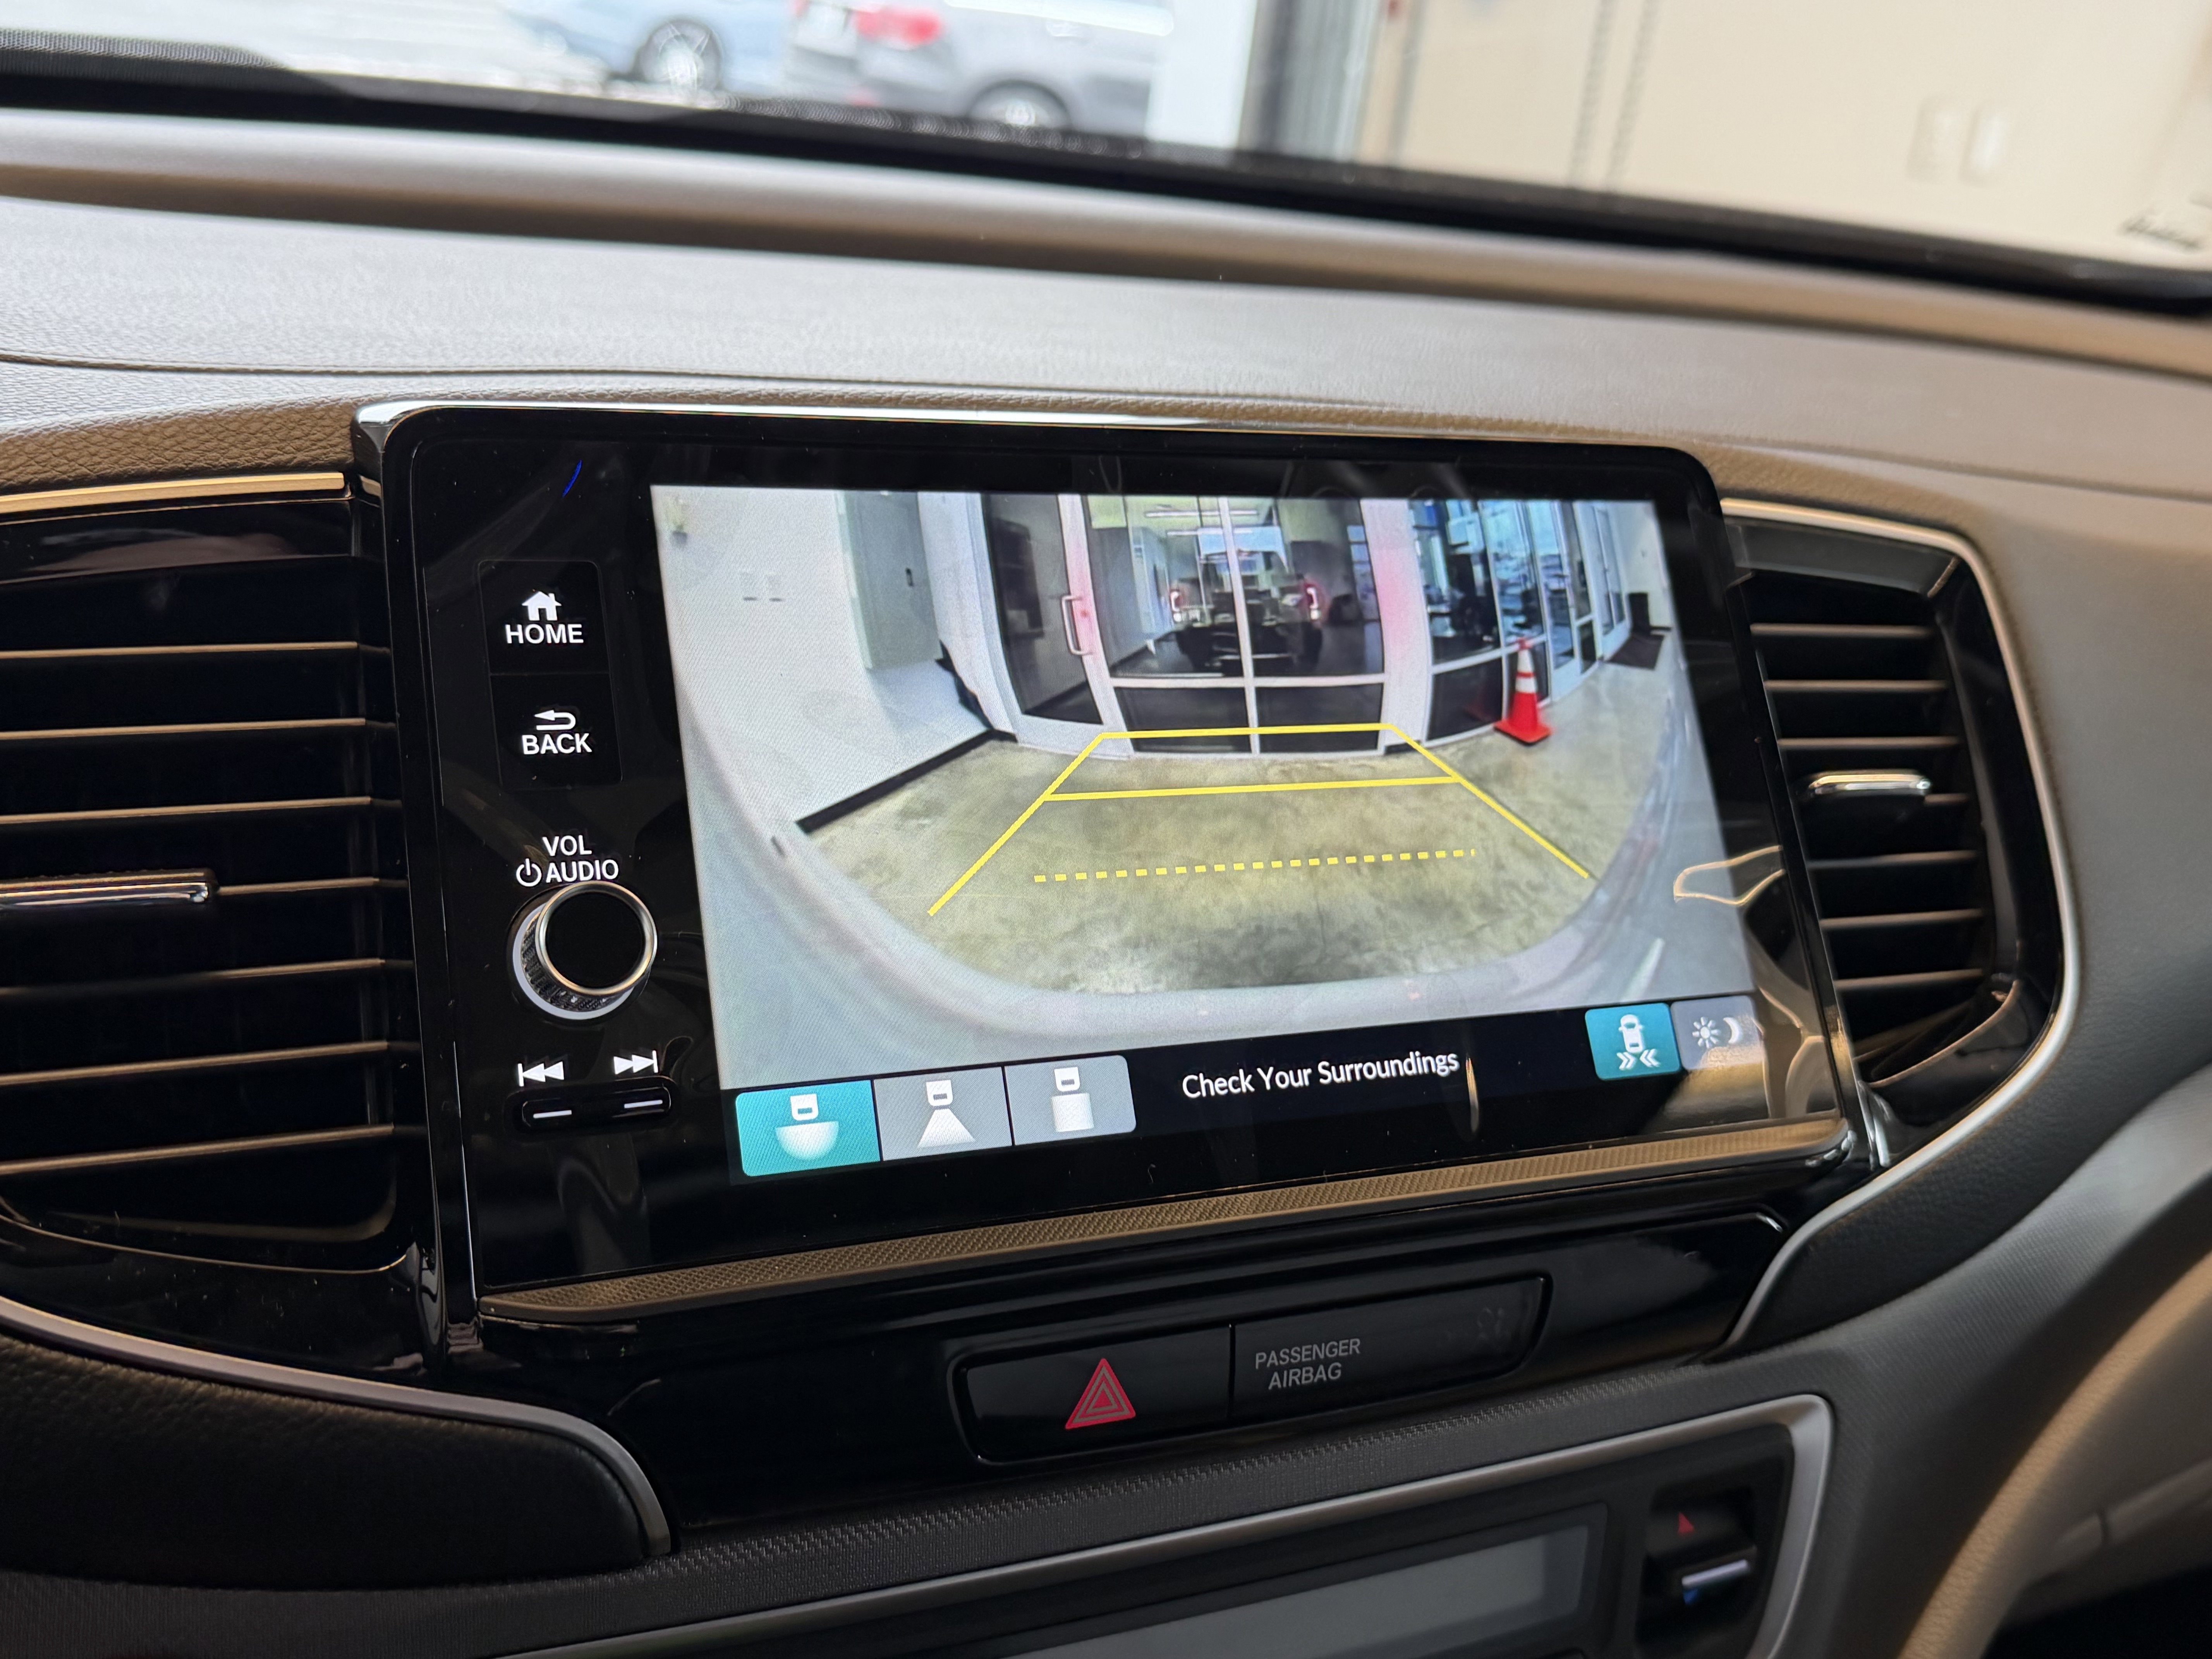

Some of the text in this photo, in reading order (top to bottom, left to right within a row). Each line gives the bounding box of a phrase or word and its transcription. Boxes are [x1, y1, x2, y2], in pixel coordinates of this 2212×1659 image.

[505, 623, 584, 644] HOME
[521, 733, 592, 755] BACK
[542, 834, 592, 857] VOL
[545, 859, 619, 883] AUDIO
[1182, 1050, 1460, 1099] Check Your Surroundings
[1255, 1338, 1361, 1370] PASSENGER
[1268, 1362, 1342, 1390] AIRBAG
